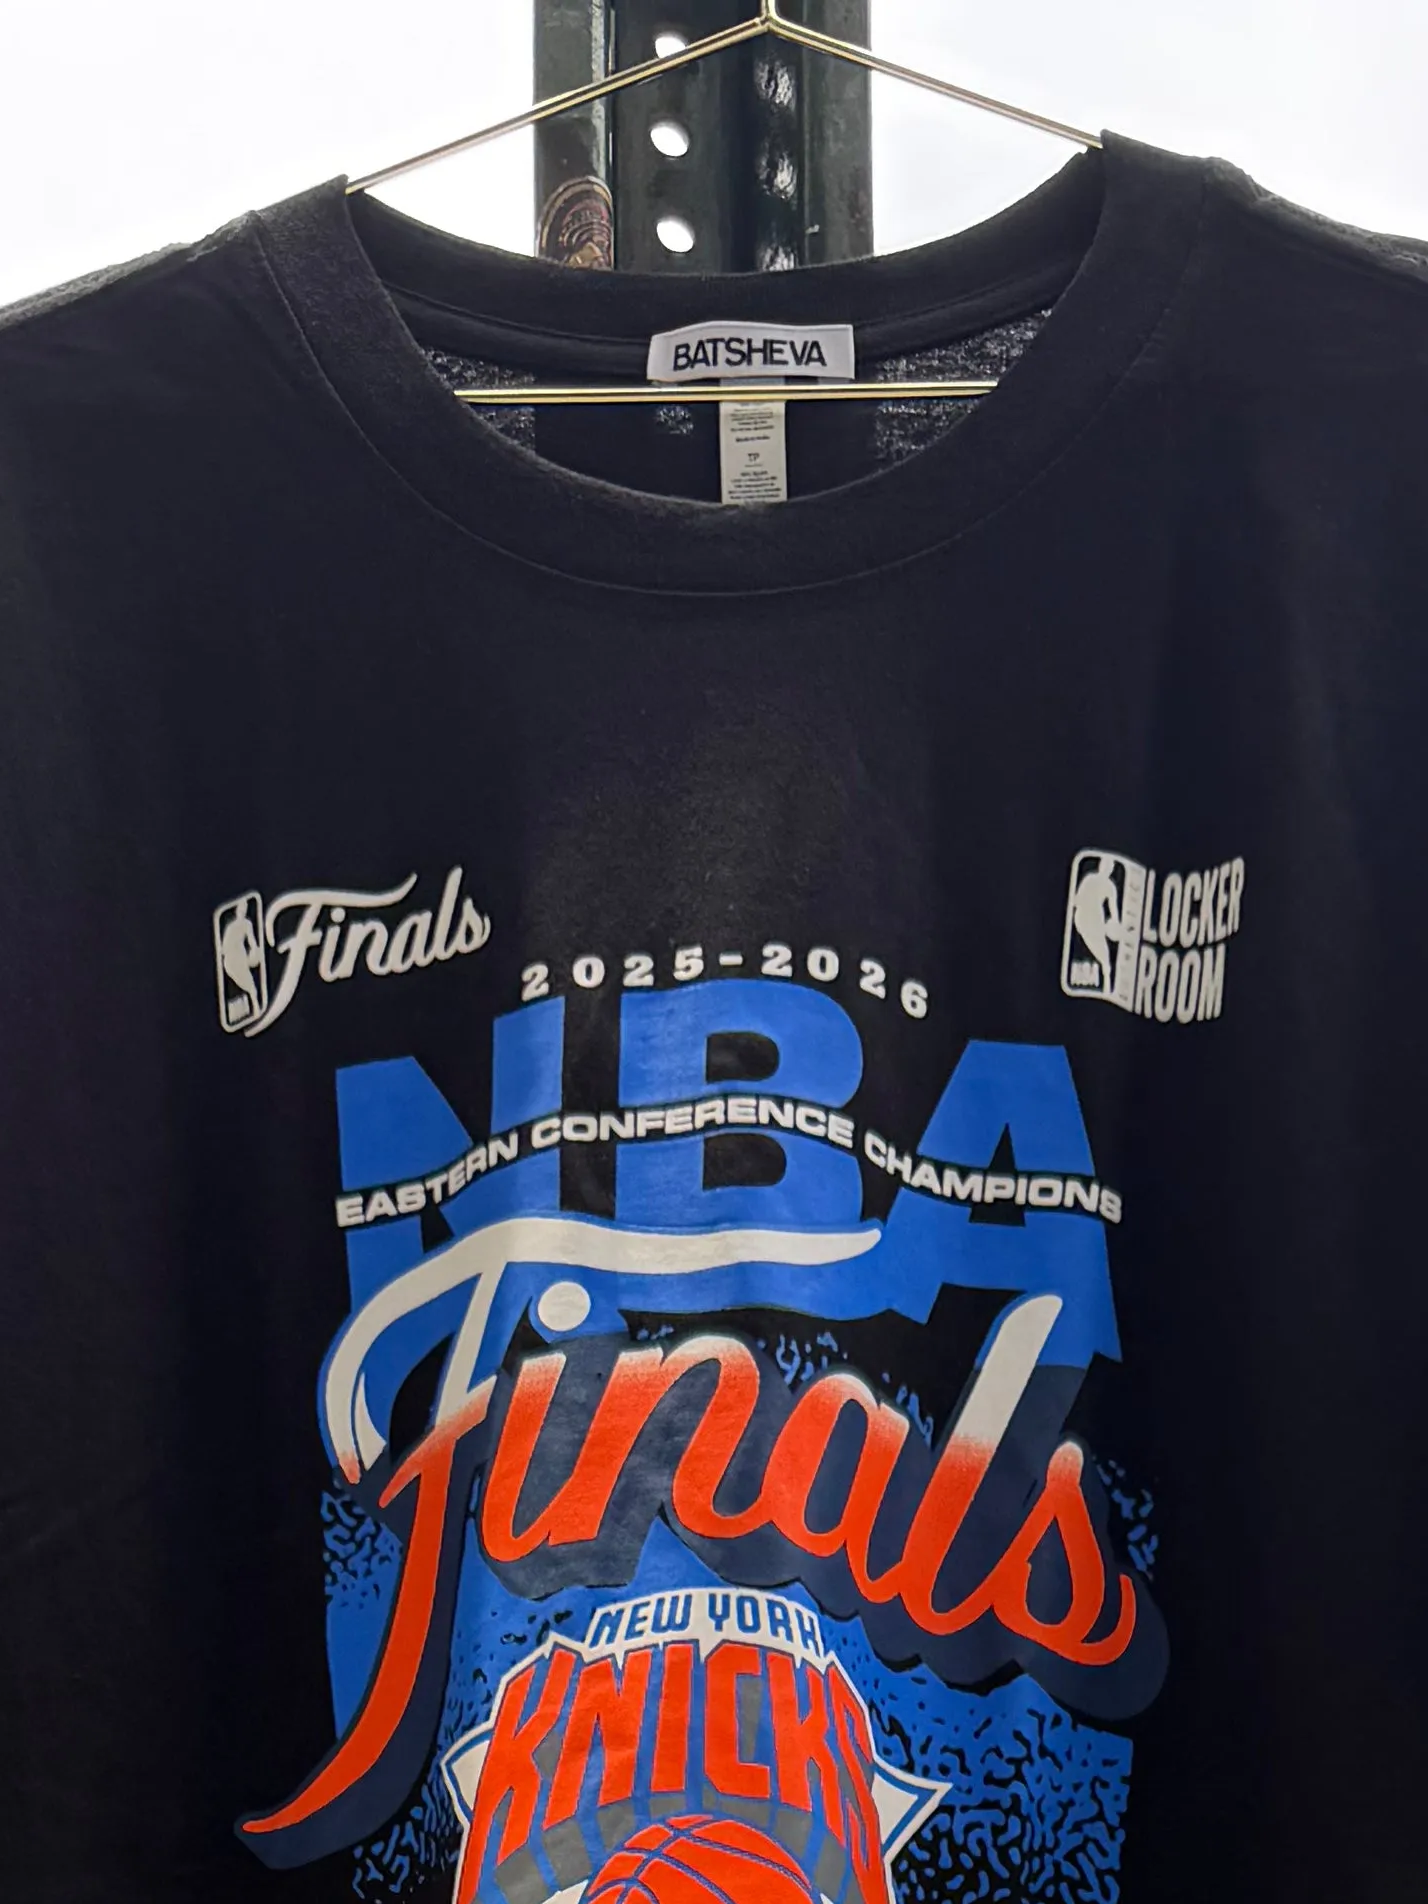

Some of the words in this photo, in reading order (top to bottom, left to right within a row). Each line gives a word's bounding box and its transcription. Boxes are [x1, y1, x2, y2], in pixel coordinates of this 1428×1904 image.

[672, 336, 827, 371] BATSHEVA
[1143, 856, 1245, 949] LOCKER
[243, 865, 491, 1038] Finals
[521, 943, 928, 1019] 2025-2026
[1134, 942, 1227, 1024] ROOM
[335, 1131, 520, 1229] EASTERN
[530, 1096, 854, 1150] CONFERENCE
[863, 1131, 1122, 1224] CHAMPIONS
[335, 977, 1123, 1364] NBA
[241, 1217, 1137, 1833] Finals
[588, 1593, 694, 1649] NEW
[707, 1592, 826, 1658] YORK
